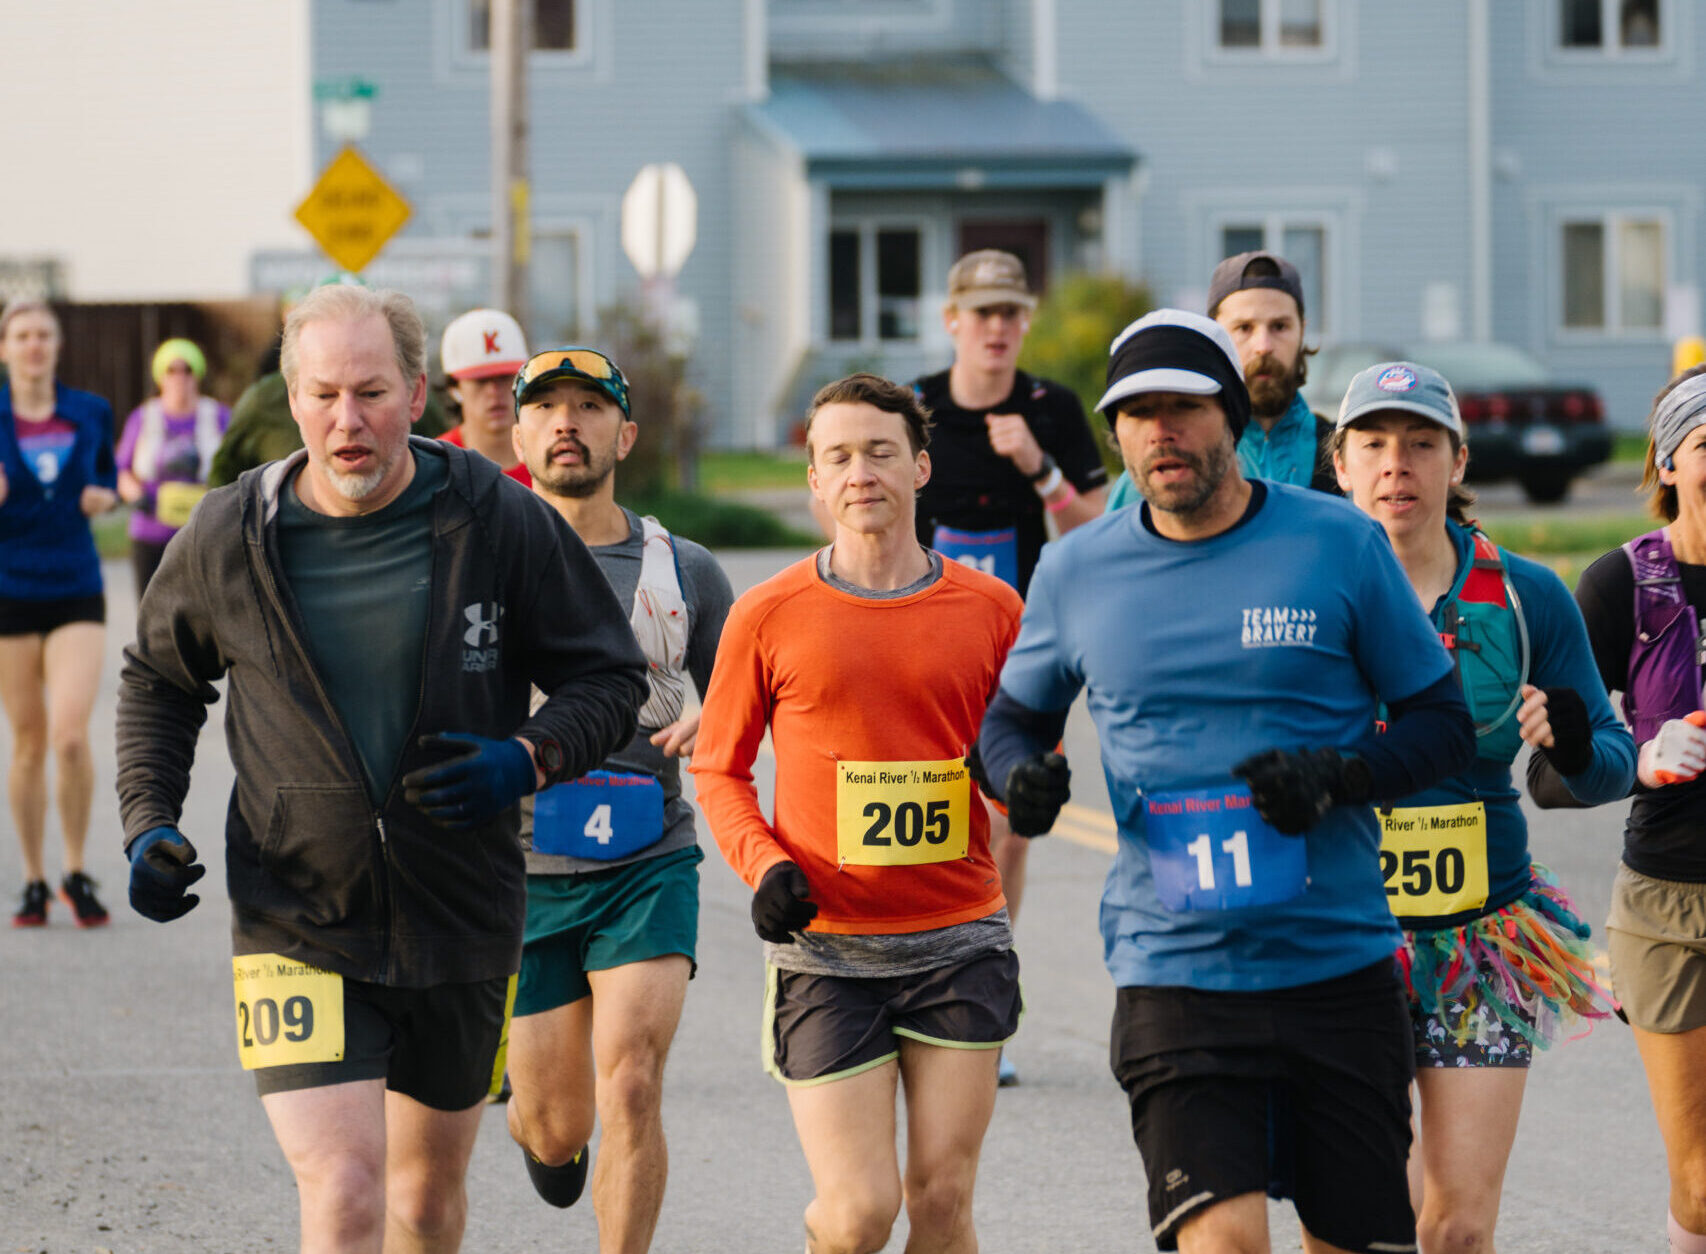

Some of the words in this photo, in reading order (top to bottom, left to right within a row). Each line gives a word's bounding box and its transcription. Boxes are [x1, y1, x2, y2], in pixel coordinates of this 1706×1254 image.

[483, 330, 501, 355] K
[1242, 606, 1289, 626] TEAM
[1241, 622, 1317, 643] BRAVERY
[846, 771, 876, 784] Kenai
[879, 771, 908, 784] River
[923, 768, 965, 783] Marathon
[1185, 797, 1221, 813] River
[583, 804, 613, 845] 4
[862, 800, 950, 847] 205
[1385, 818, 1415, 832] River
[1431, 814, 1479, 830] Marathon
[1187, 830, 1252, 891] 11
[1380, 847, 1465, 896] 250
[239, 995, 314, 1048] 209
